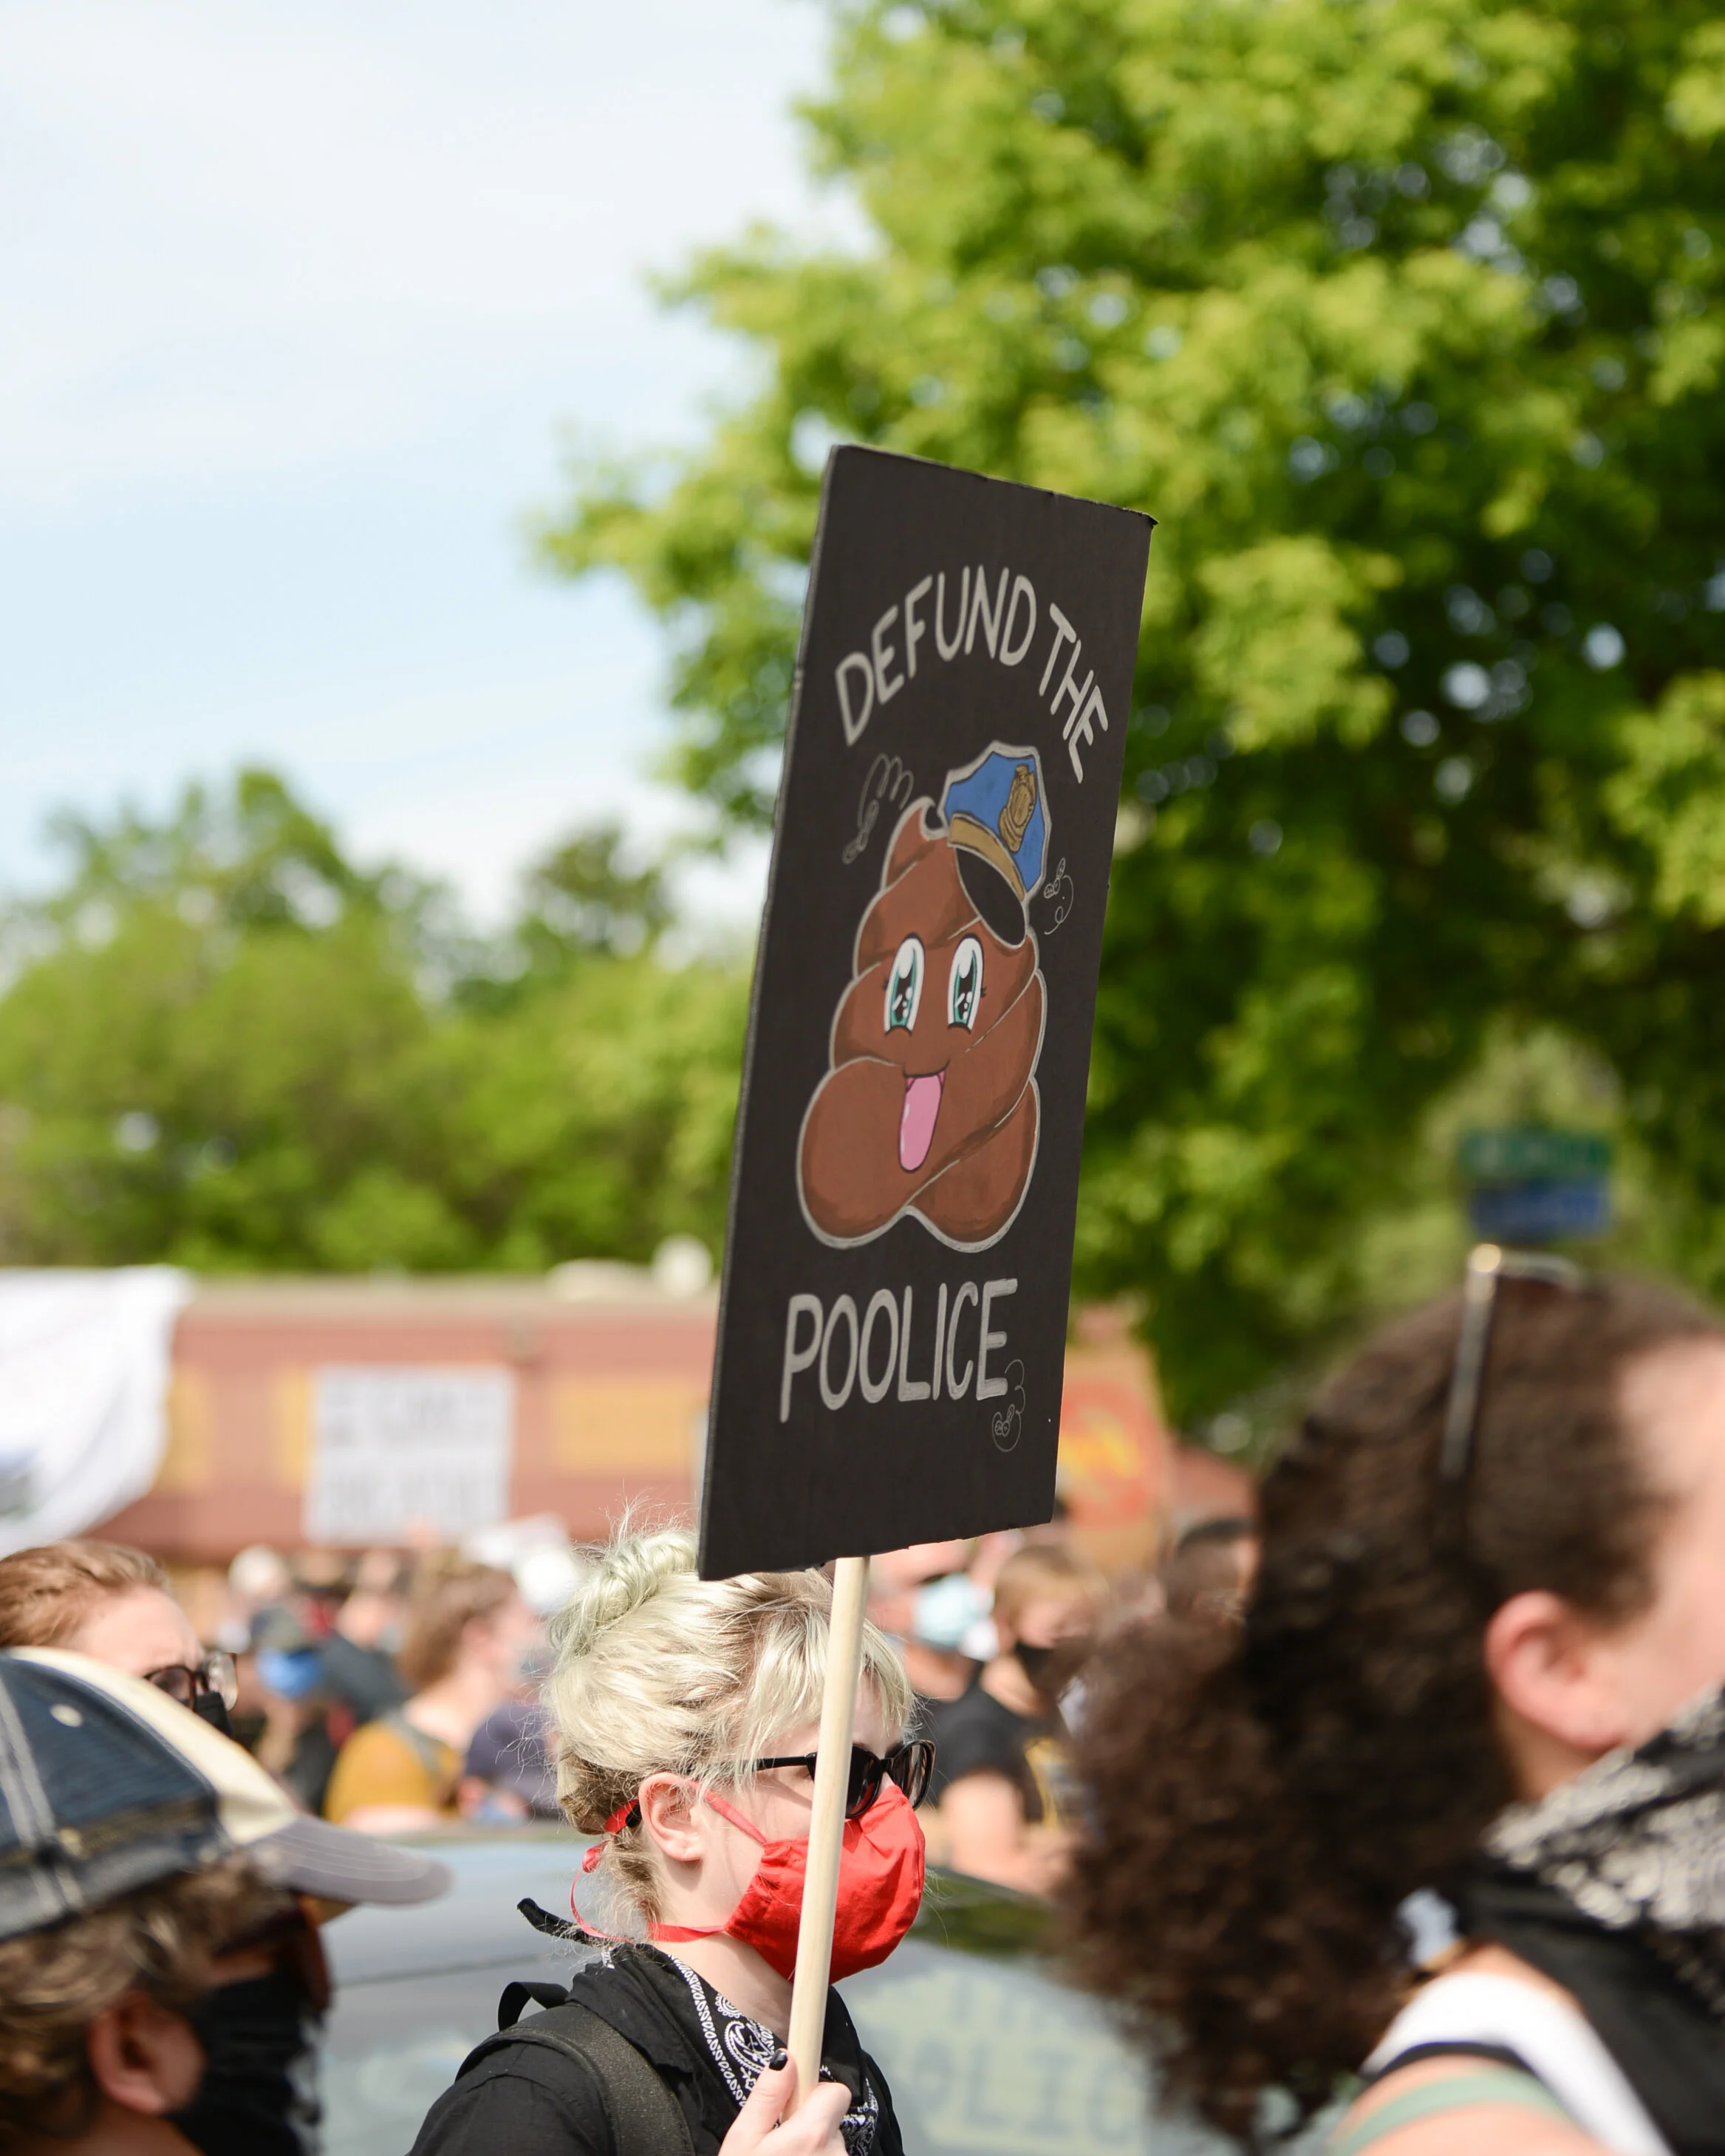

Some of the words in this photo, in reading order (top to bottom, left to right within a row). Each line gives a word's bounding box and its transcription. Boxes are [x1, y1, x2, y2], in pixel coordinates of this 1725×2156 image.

[835, 564, 1036, 747] DEFUND
[1038, 602, 1108, 784] THE
[779, 1278, 1018, 1424] POOLICE
